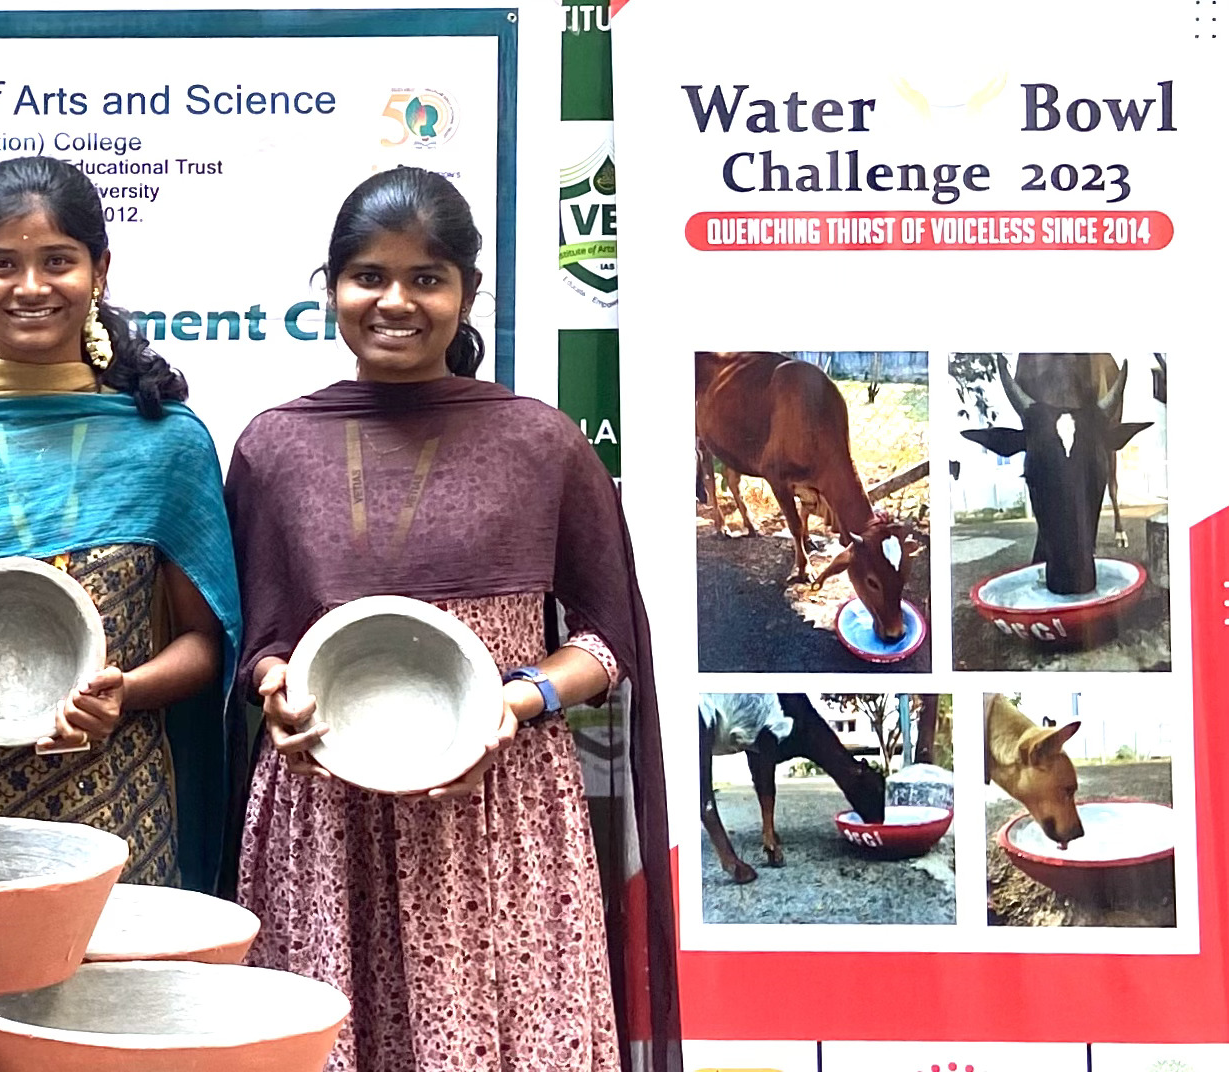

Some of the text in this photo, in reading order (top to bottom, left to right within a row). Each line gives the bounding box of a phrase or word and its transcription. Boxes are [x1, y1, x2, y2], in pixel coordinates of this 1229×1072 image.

[13, 84, 88, 116] Arts
[102, 84, 170, 116] and
[185, 84, 336, 115] Science
[680, 80, 1178, 134] Water Bowl
[54, 132, 142, 156] College
[71, 160, 169, 176] ducational
[175, 158, 223, 175] Trust
[722, 149, 1131, 205] Challenge 2023
[570, 204, 617, 235] VE
[707, 217, 1152, 245] QUENCHING THIRST OF VOICELESS SINCE 2014
[587, 245, 597, 255] of
[598, 245, 615, 253] Arts
